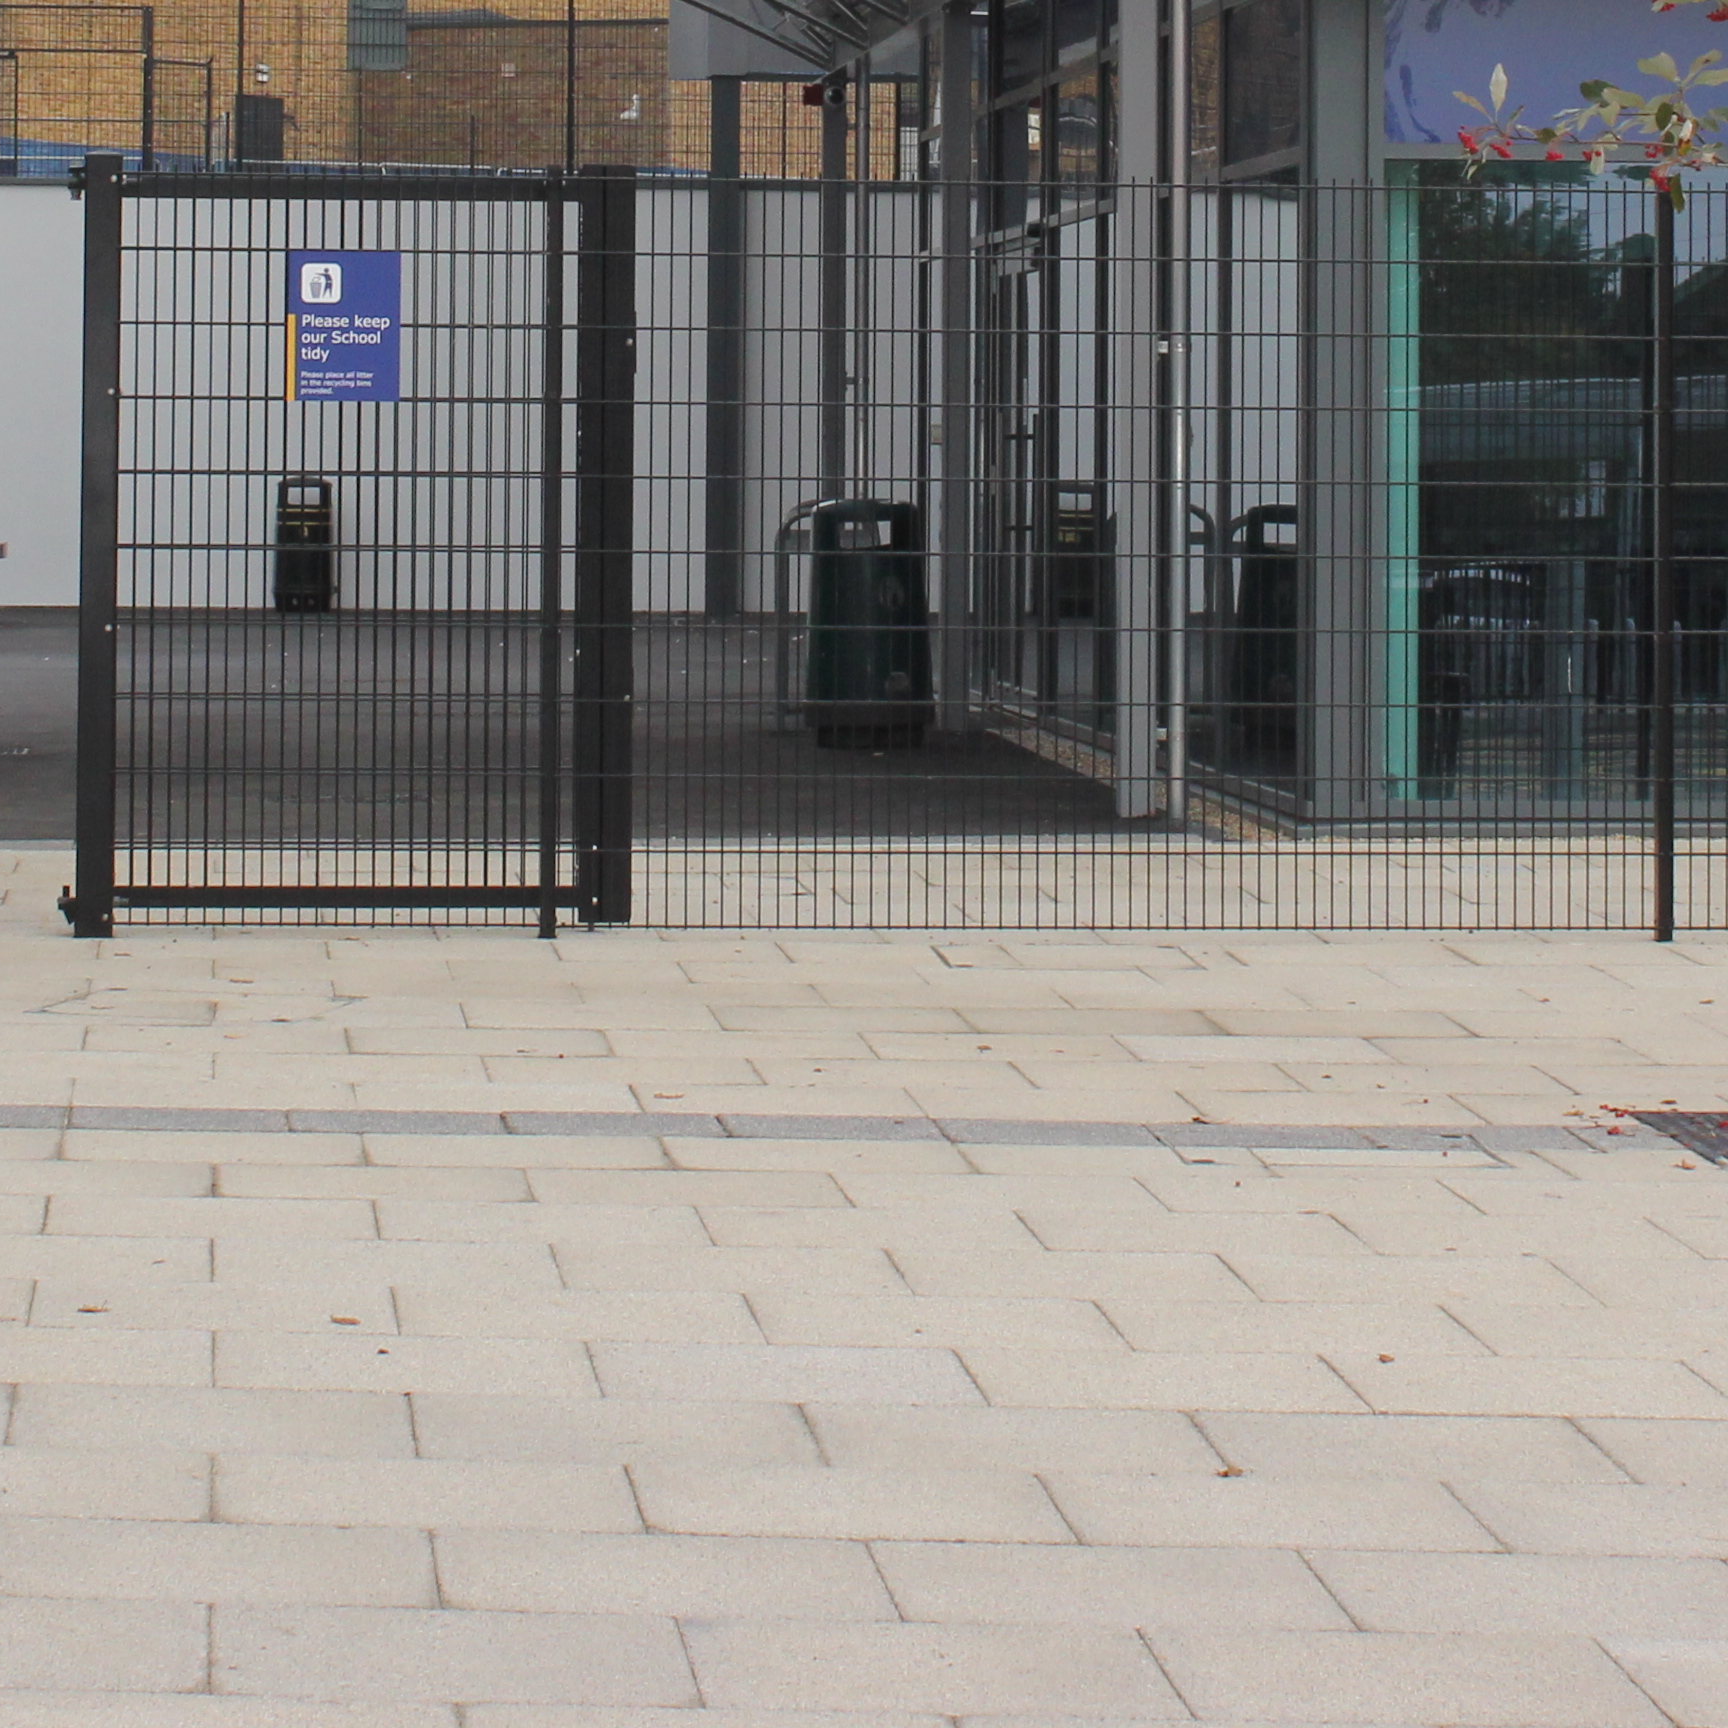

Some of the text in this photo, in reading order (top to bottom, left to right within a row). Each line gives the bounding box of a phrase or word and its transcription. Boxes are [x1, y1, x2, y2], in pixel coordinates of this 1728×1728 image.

[302, 314, 390, 330] Please keep
[301, 330, 381, 344] our School
[301, 347, 330, 363] tidy
[301, 371, 324, 379] Please
[309, 379, 322, 387] the
[323, 379, 355, 388] recycling
